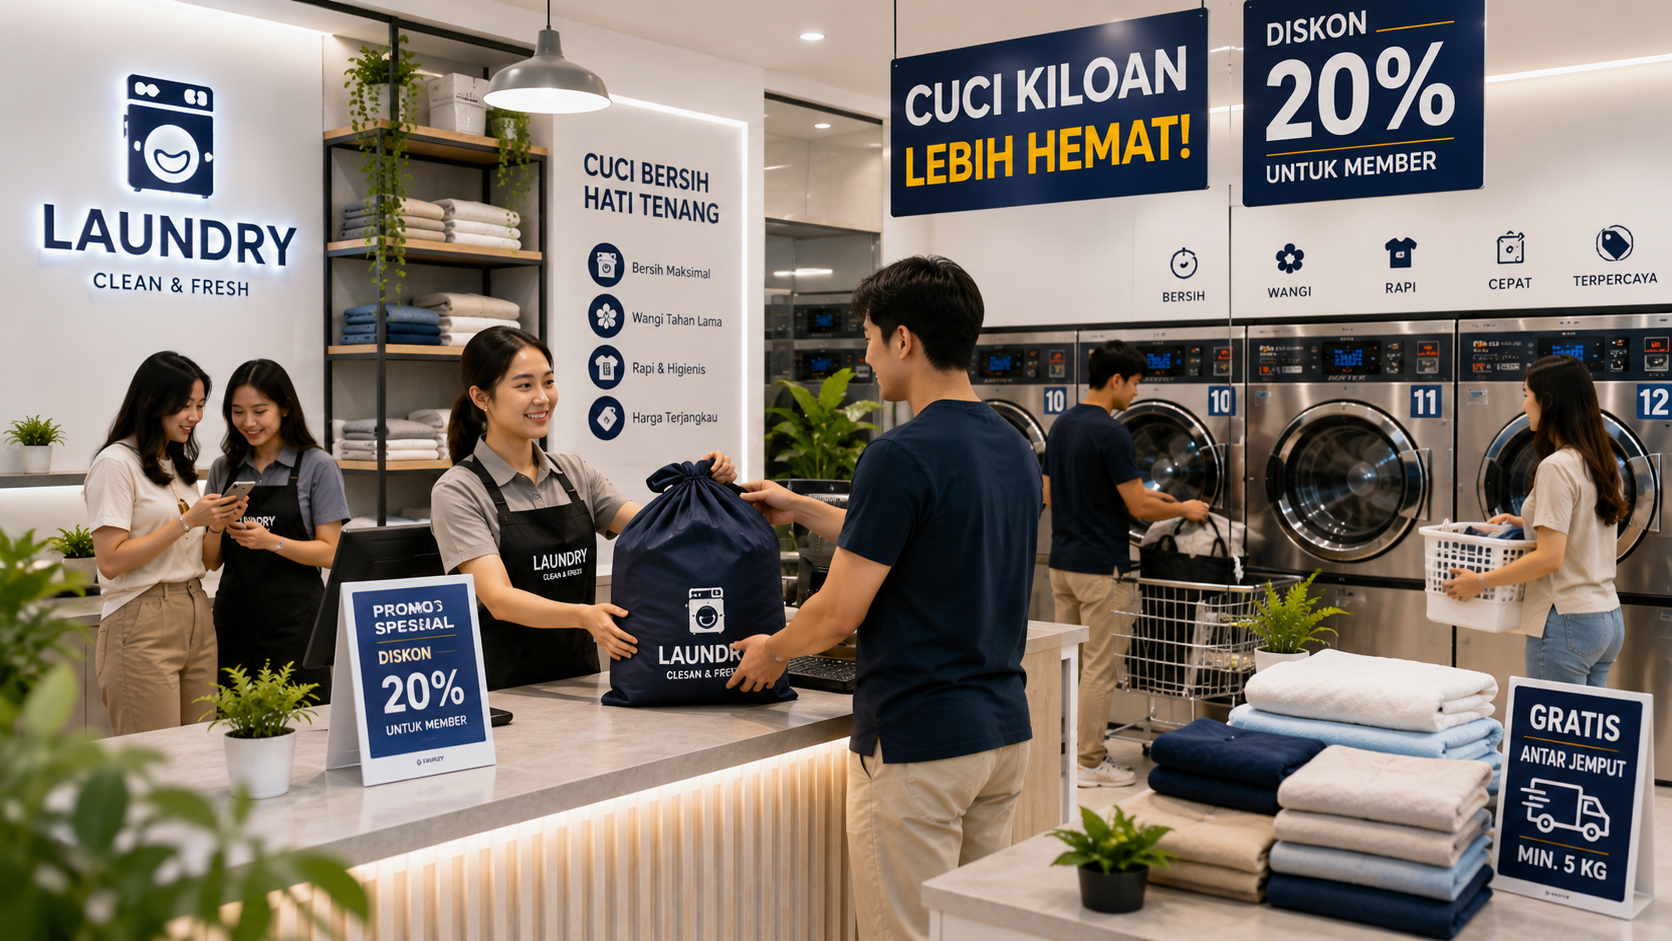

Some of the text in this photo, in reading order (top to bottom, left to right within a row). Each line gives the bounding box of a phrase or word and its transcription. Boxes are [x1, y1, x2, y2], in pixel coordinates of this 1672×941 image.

[1266, 9, 1367, 46] DISKON
[905, 45, 1187, 126] CUCI KILOAN
[1266, 41, 1455, 142] 20%
[905, 113, 1191, 188] LEBIH HEMAT!
[583, 152, 709, 194] CUCI BERSIH
[1266, 151, 1437, 184] UNTUK MEMBER
[584, 185, 719, 224] HATI TENANG
[43, 203, 297, 267] LAUNDRY
[632, 261, 711, 279] Bersih Maksimal
[1573, 272, 1658, 287] TERPERCAYA
[93, 272, 249, 297] CLEAN & FRESH
[1267, 286, 1312, 298] WANGI
[1385, 282, 1416, 293] RAPI
[1488, 277, 1532, 290] CEPAT
[1162, 291, 1205, 302] BERSIH
[632, 311, 722, 327] Wangi Tahan Lama
[632, 362, 706, 377] Rapi & Higienis
[1046, 390, 1065, 412] 10
[1211, 389, 1231, 413] 10
[1414, 389, 1436, 415] 11
[1639, 388, 1669, 415] 12
[632, 411, 718, 426] Harga Terjangkau
[533, 547, 588, 571] LAUNDRY
[378, 646, 432, 665] DISKON
[658, 644, 745, 665] LAUNDR
[666, 669, 702, 680] CLESAN
[704, 669, 712, 678] &
[381, 668, 465, 715] 20%
[386, 715, 467, 736] UNTUK MEMBER
[1530, 703, 1621, 742] GRATIS
[1520, 745, 1626, 778] ANTAR JEMPUT
[1517, 844, 1607, 881] MIN. 5 KG
